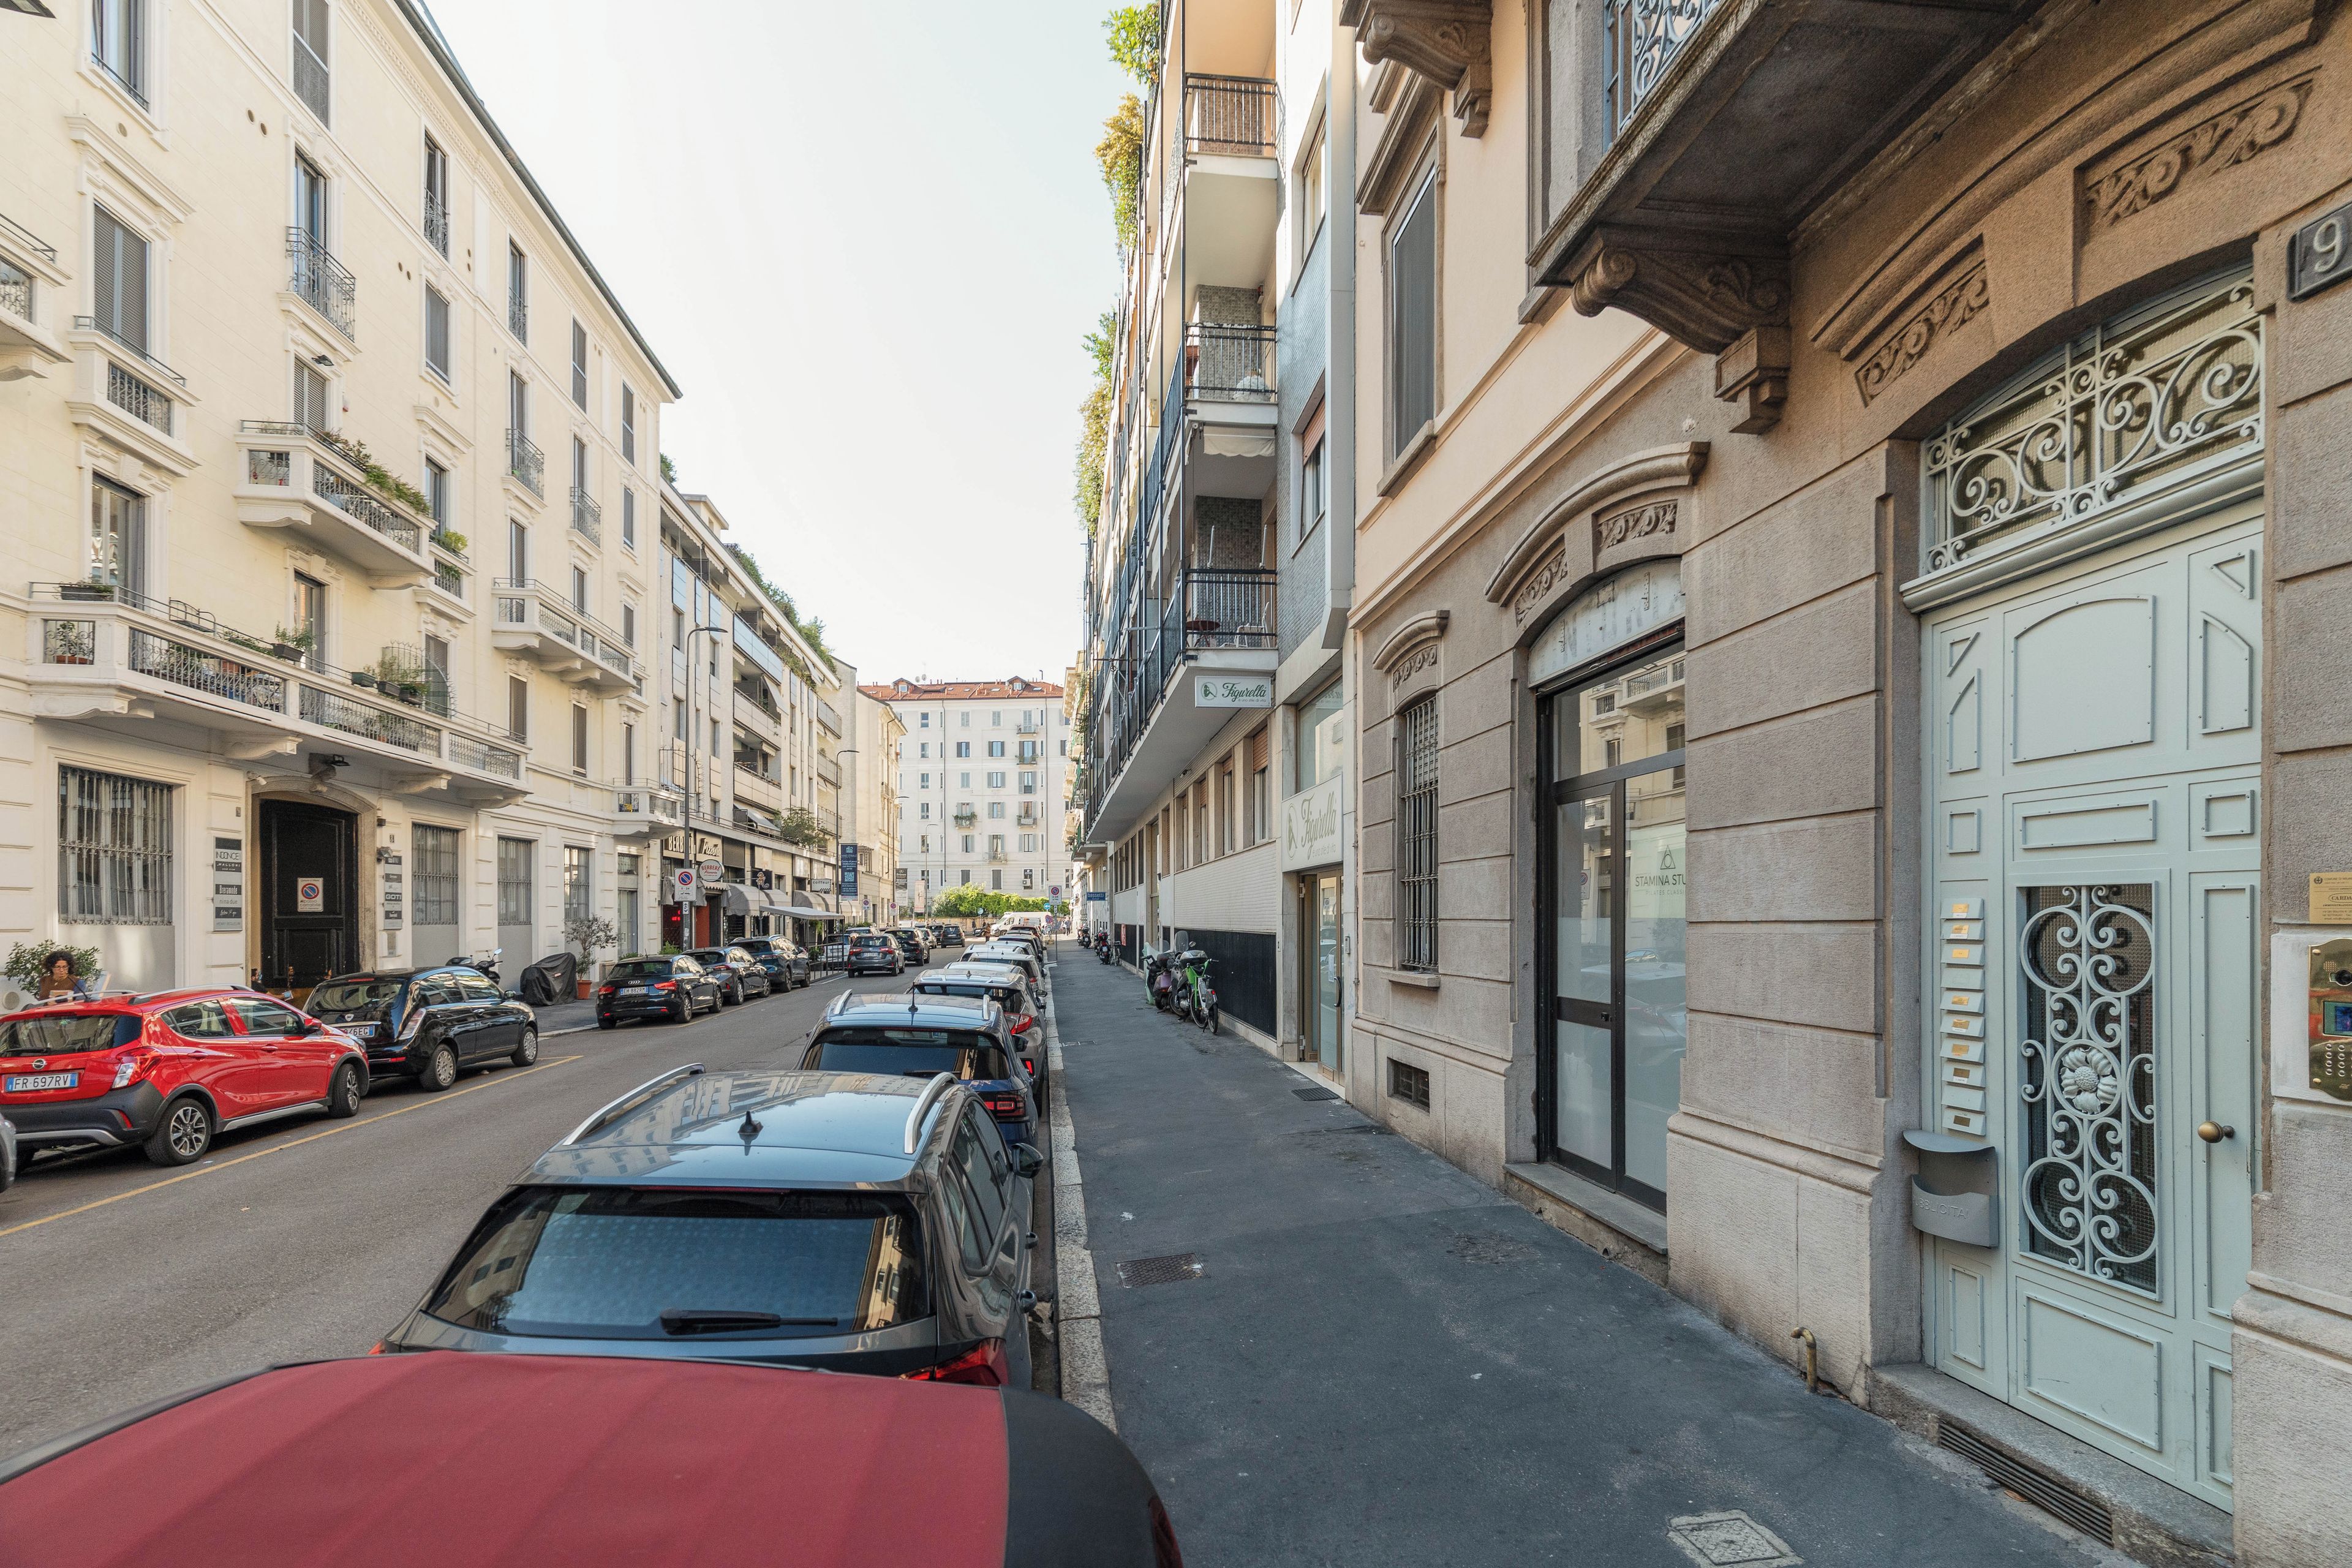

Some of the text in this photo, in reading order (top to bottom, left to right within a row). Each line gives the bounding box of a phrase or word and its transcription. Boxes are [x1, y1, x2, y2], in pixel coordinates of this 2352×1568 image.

[2313, 217, 2343, 273] 9
[1222, 682, 1267, 703] Figurella
[1301, 791, 1337, 861] Figurella
[1635, 873, 1686, 887] STAMINA STU
[14, 1075, 69, 1089] FR 697RV
